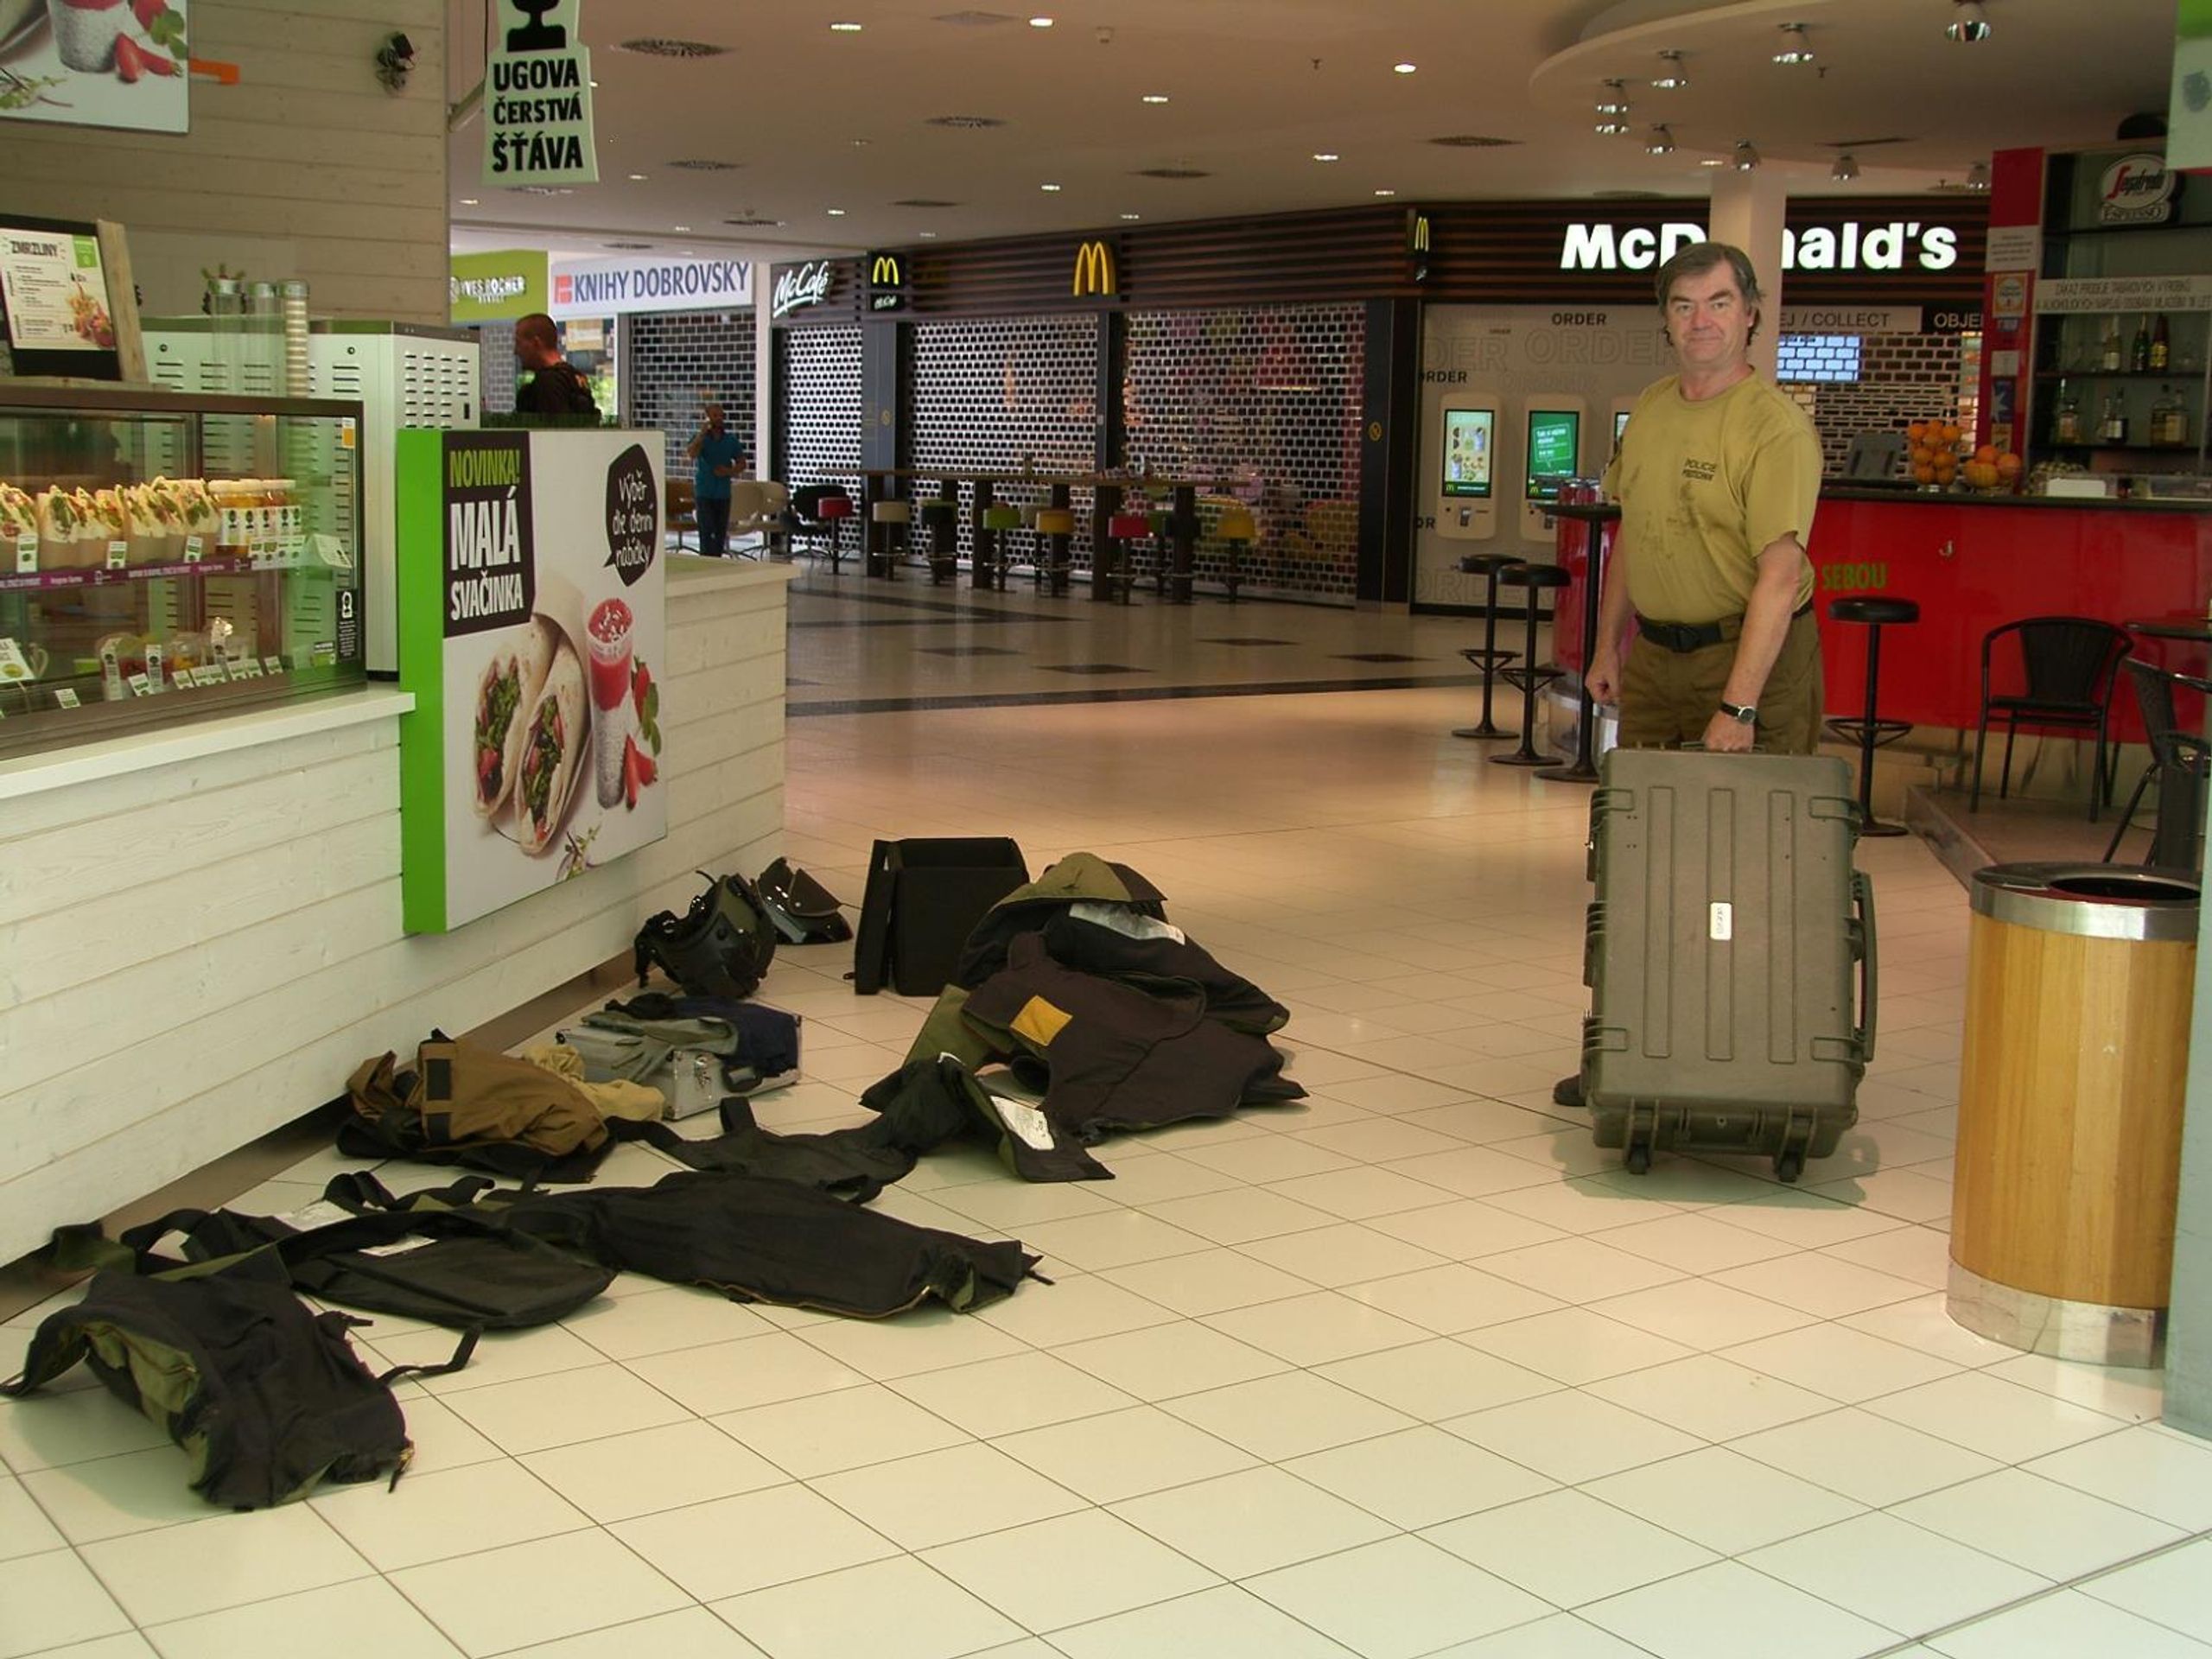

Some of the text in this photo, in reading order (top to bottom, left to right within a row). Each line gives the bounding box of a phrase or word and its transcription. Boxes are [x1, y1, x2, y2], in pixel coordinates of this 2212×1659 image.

[493, 58, 581, 91] UGOVA
[493, 92, 582, 125] ČERSTVÁ
[493, 131, 583, 173] ŠŤÁVA
[1560, 222, 1957, 270] McDald's
[575, 270, 630, 302] KNIHY
[773, 261, 830, 317] McCafé
[1551, 312, 1607, 326] ORDER
[1811, 313, 1891, 327] COLLECT
[1934, 313, 1984, 328] OBJE
[449, 448, 520, 488] NOVINKA!
[619, 468, 648, 510] Výběr
[449, 486, 521, 571] MALÁ
[612, 502, 654, 536] dle denní
[616, 536, 652, 570] nabídky
[1821, 563, 1887, 591] SEBOU
[450, 570, 524, 621] SVAČINKA
